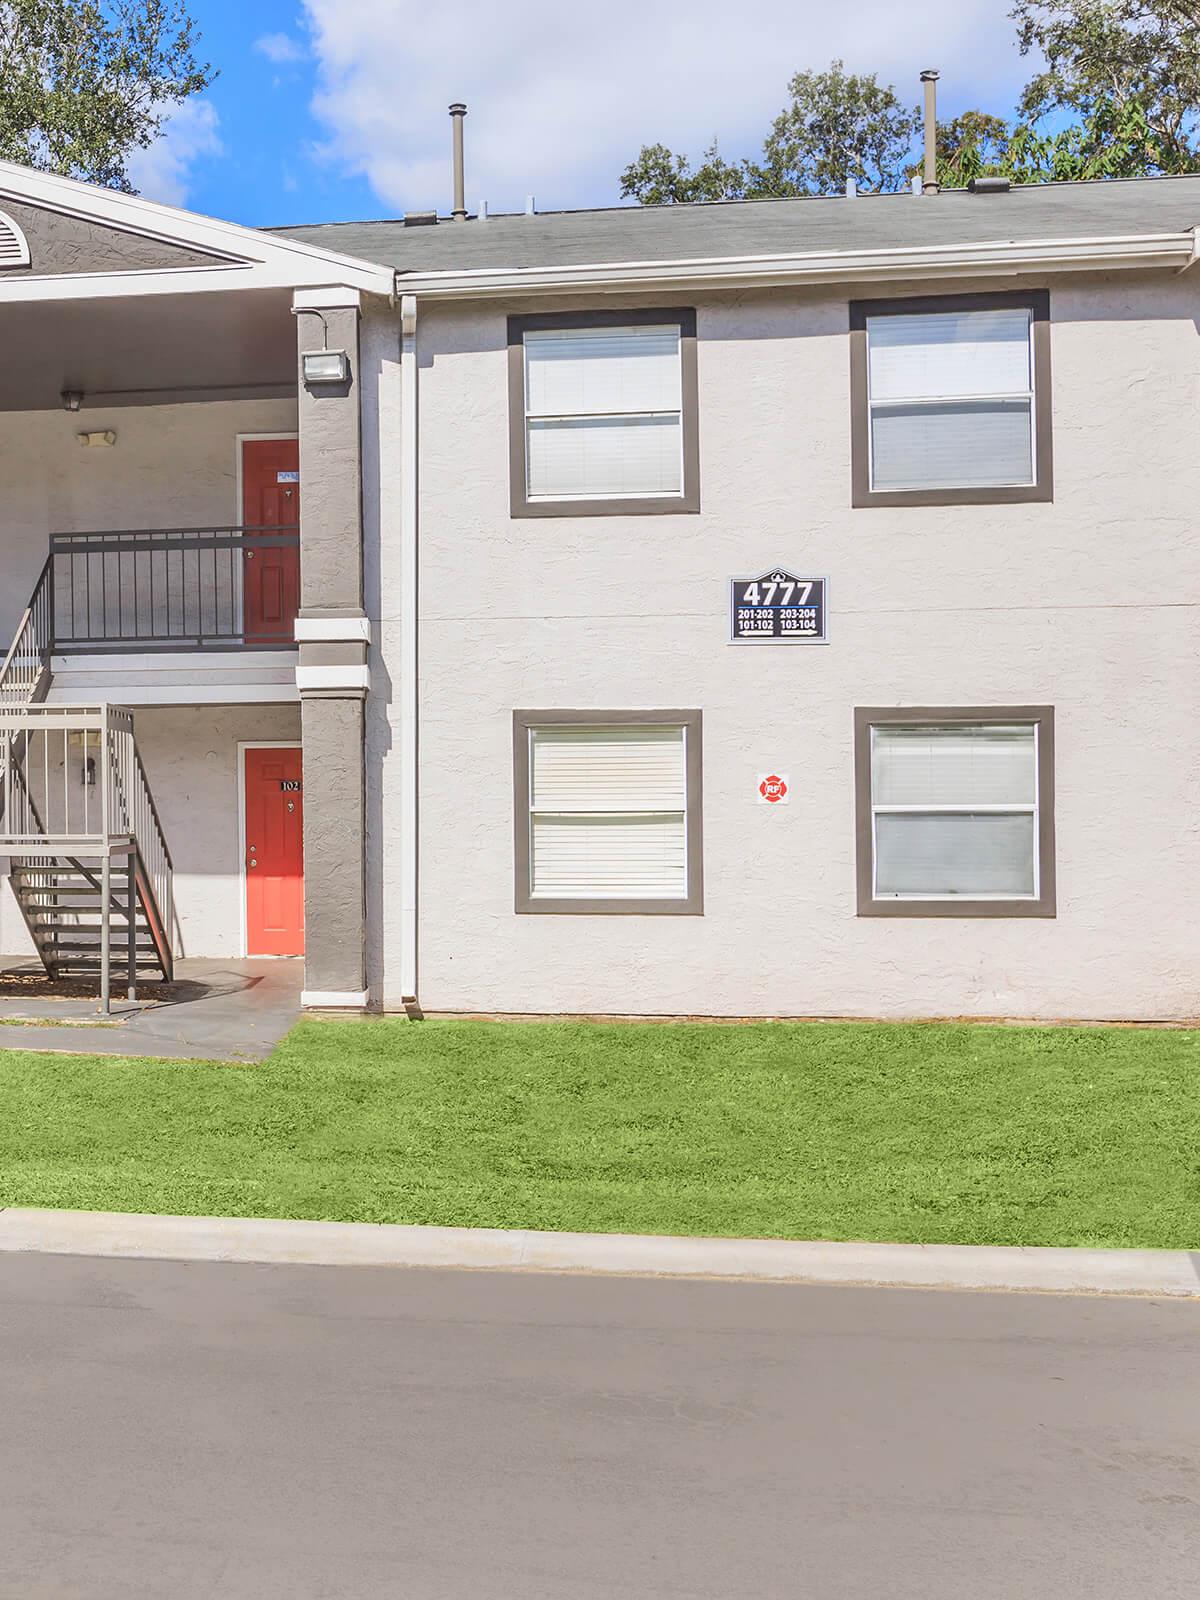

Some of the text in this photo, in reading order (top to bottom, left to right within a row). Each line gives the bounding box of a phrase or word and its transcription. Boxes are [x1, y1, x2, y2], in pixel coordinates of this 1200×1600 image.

[743, 582, 813, 606] 4777
[738, 609, 774, 619] 201-202
[780, 609, 816, 619] 203-204
[738, 620, 774, 630] 101-102
[781, 620, 816, 630] 103-104
[283, 781, 298, 791] 102
[767, 785, 780, 793] RF
